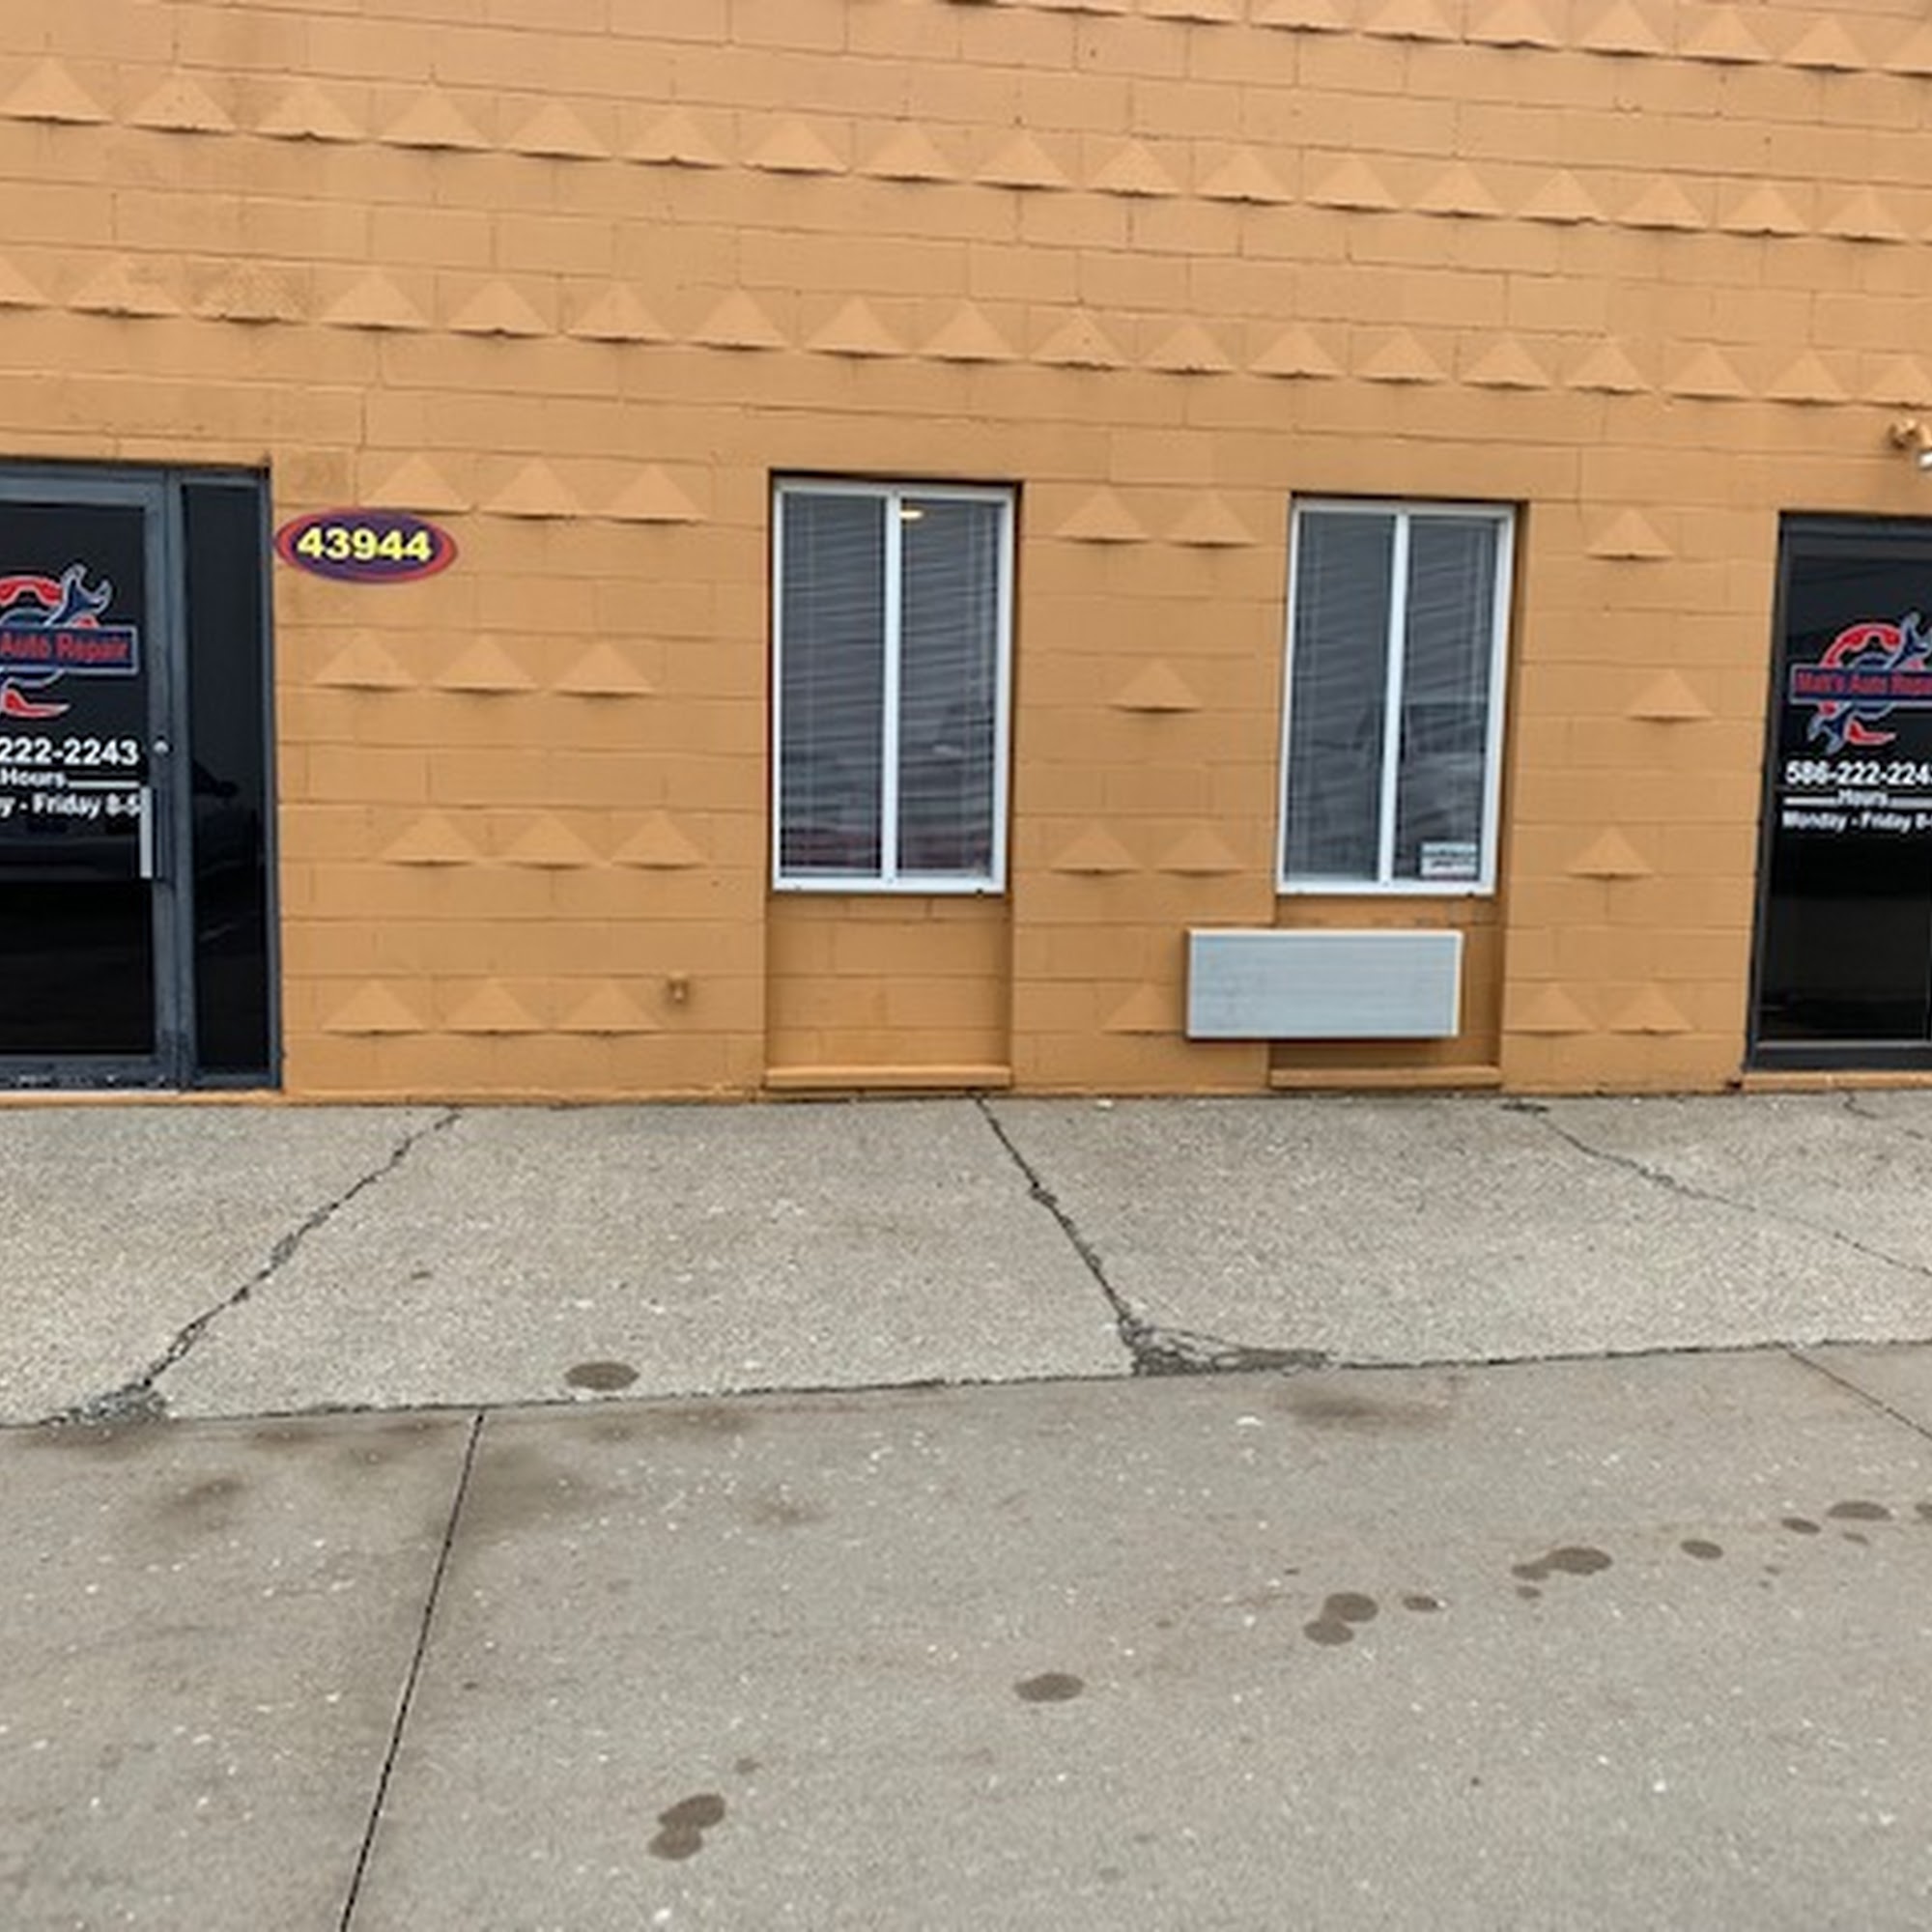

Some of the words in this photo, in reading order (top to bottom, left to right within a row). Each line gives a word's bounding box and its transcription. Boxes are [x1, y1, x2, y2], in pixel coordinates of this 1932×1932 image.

[298, 527, 433, 560] 43944
[0, 632, 51, 660] Auto
[56, 634, 128, 664] Repair
[0, 737, 139, 765] 222-2243
[0, 768, 66, 787] Hours
[1786, 760, 1932, 785] 586-222-224
[33, 793, 100, 819] Friday
[1782, 810, 1847, 832] Monday
[1861, 811, 1912, 833] Friday
